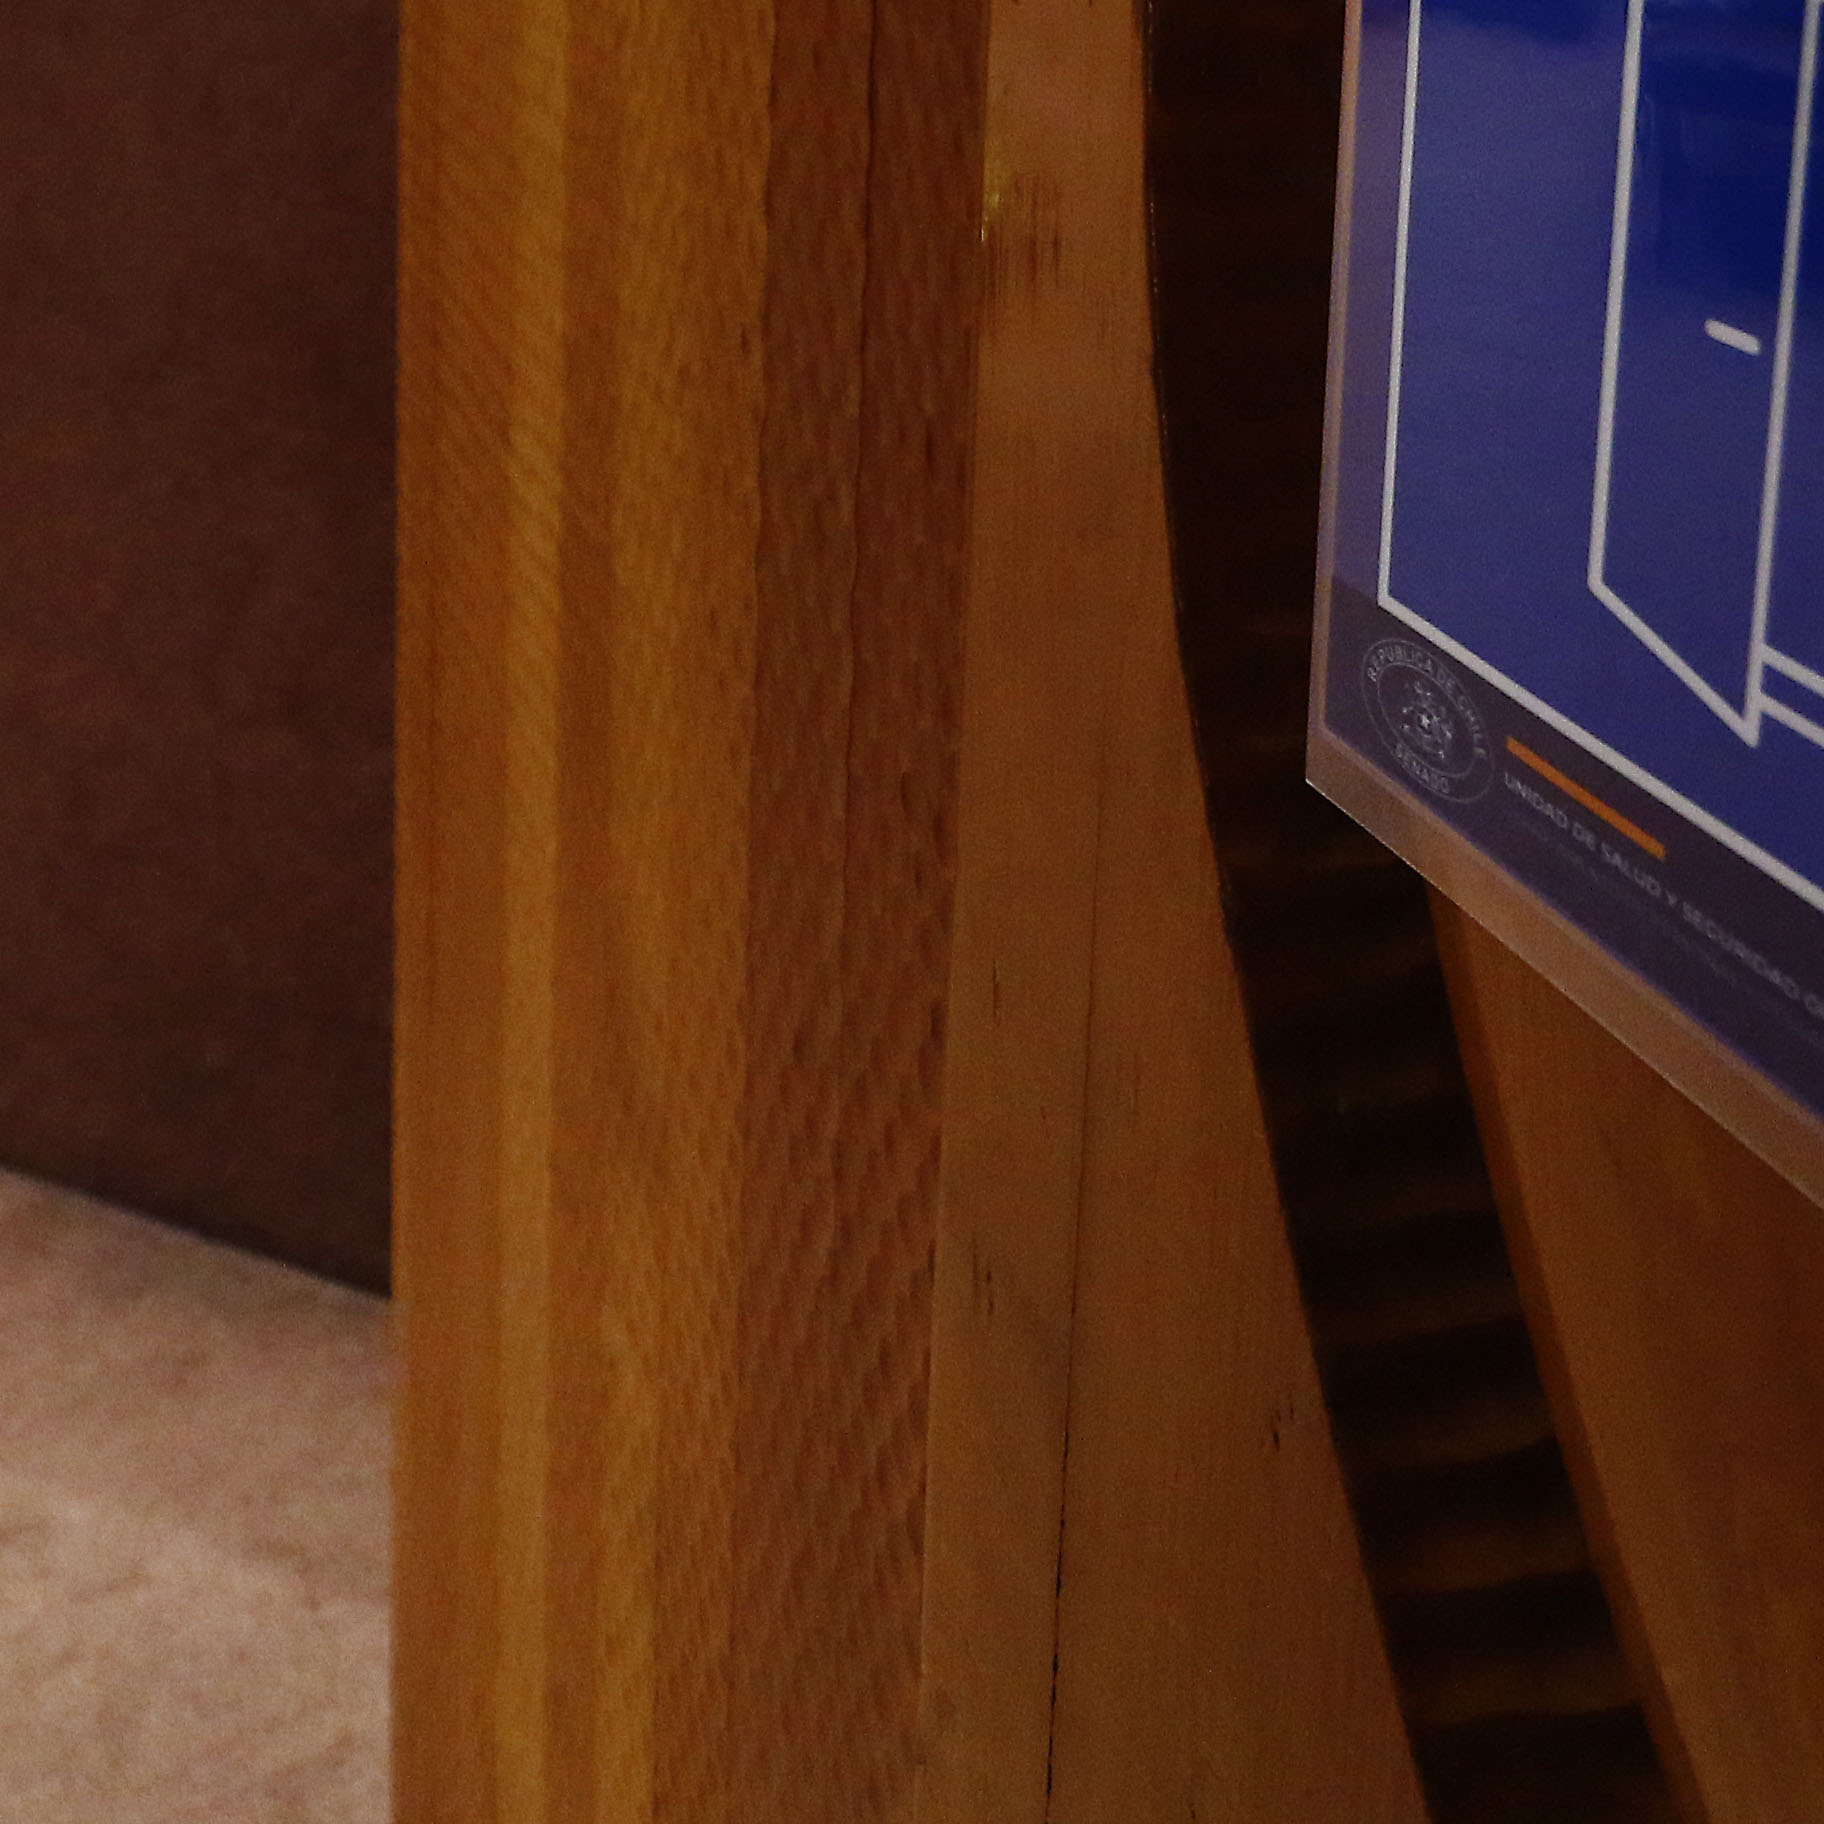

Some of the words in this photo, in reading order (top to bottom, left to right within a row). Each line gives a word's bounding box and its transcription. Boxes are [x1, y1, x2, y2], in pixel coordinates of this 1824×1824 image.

[1504, 772, 1568, 829] UNIDAD
[1572, 822, 1597, 850] DE
[1600, 842, 1662, 898] SALUD
